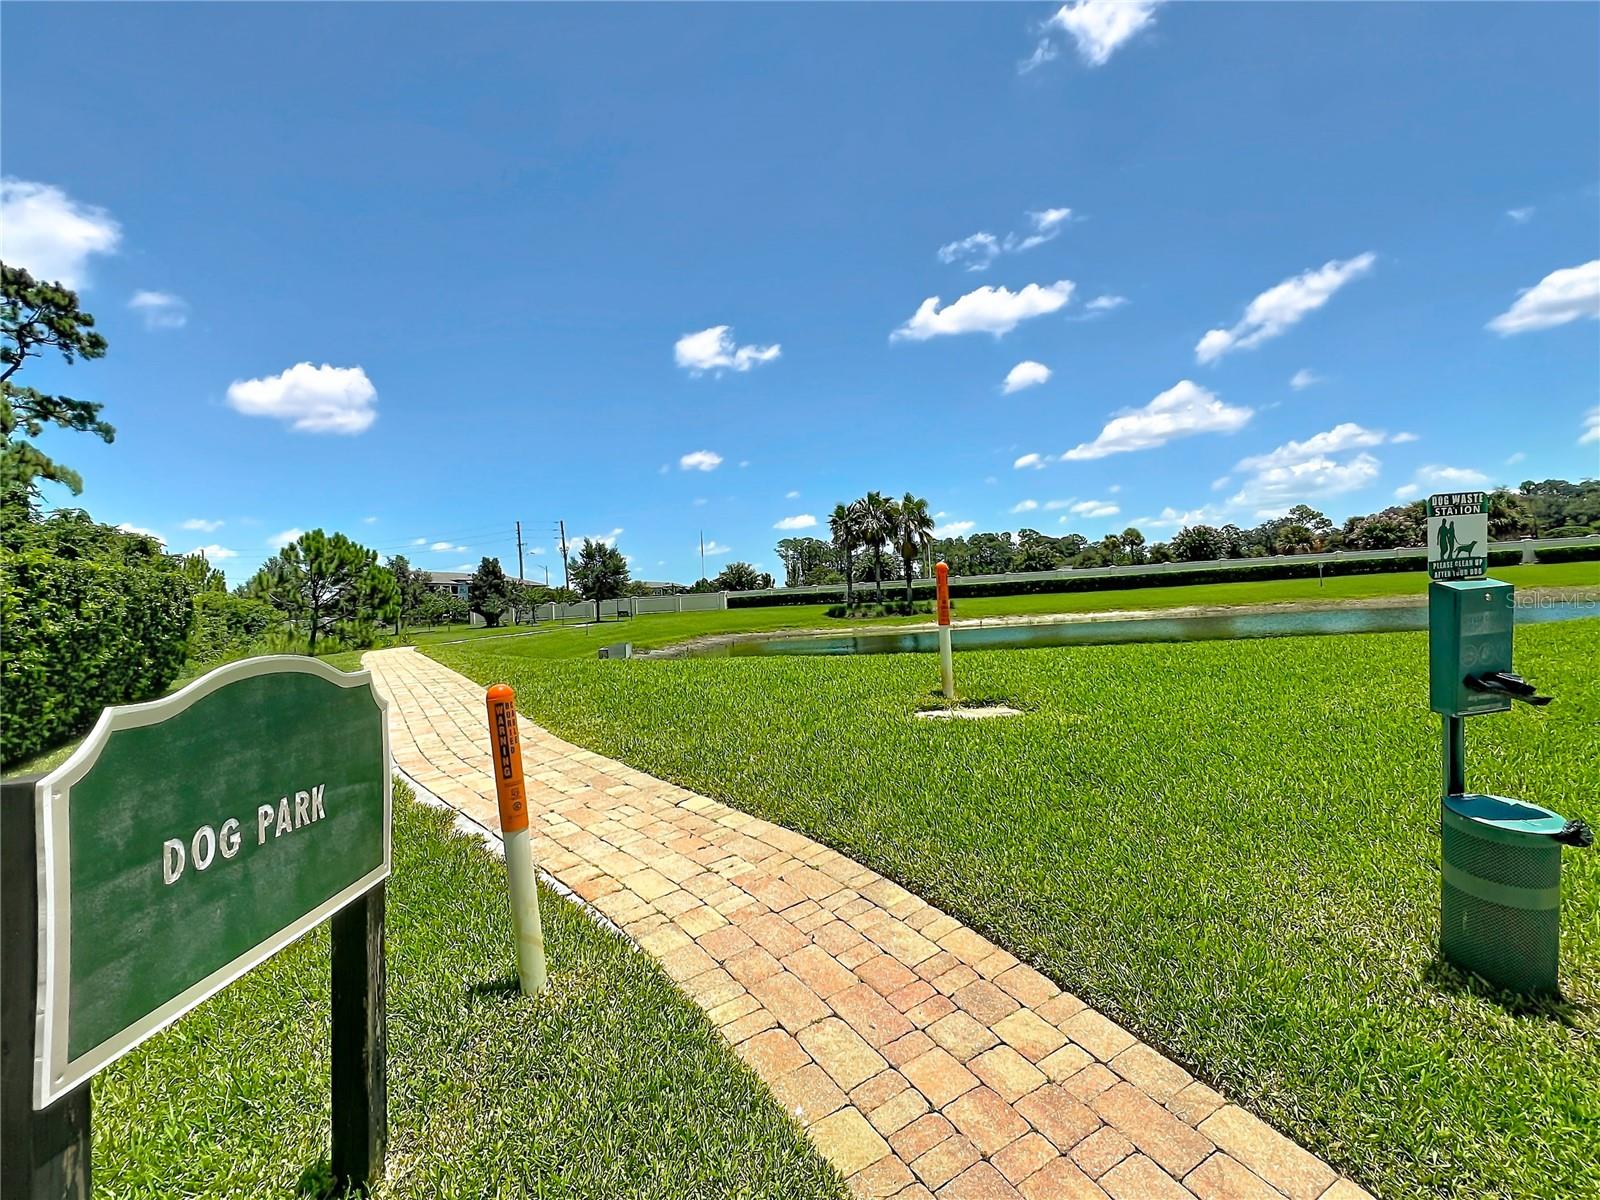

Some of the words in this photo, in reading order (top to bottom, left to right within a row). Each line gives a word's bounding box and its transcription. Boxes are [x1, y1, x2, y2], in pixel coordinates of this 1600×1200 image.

[1432, 495, 1449, 506] DOG
[1453, 493, 1484, 505] WASTE
[1435, 505, 1480, 516] STATION
[1433, 561, 1453, 570] PLEASE
[1434, 571, 1451, 579] AFTER
[505, 702, 515, 754] BURIED
[496, 704, 511, 777] WARNING
[163, 817, 241, 885] DOG
[257, 783, 326, 846] PARK
